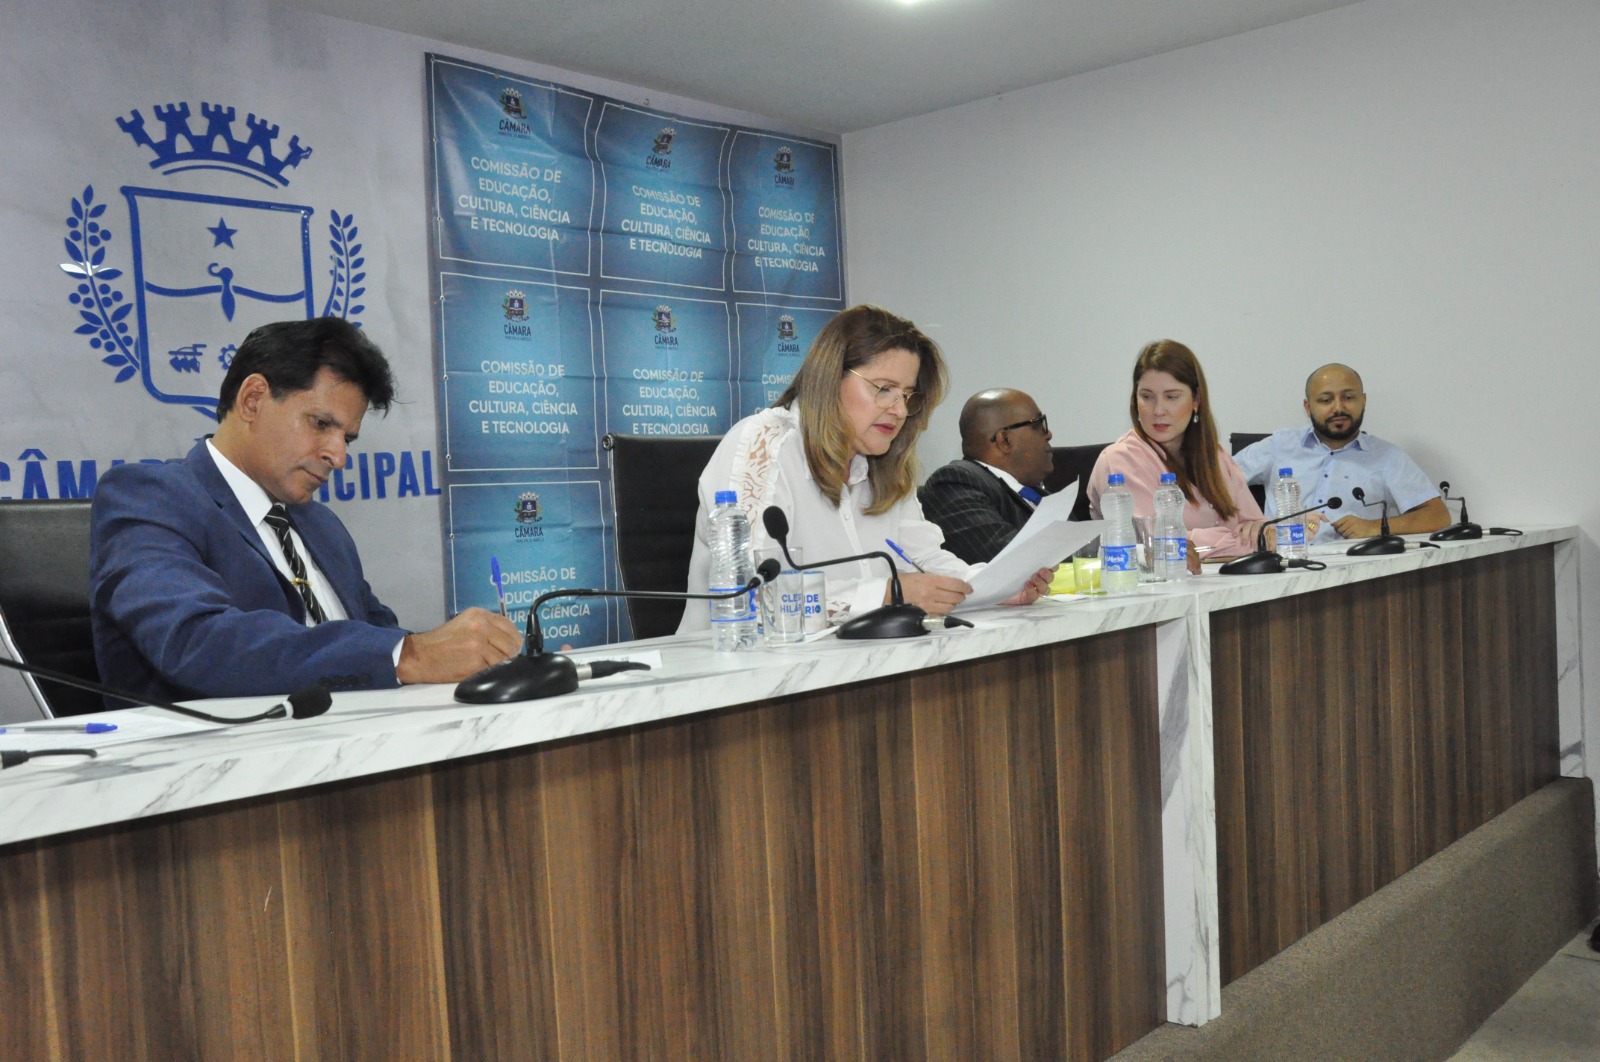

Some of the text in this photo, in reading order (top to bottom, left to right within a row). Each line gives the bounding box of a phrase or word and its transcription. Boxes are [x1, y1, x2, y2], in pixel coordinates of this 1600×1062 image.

[471, 157, 562, 183] COMISSÃO DE
[479, 177, 551, 203] EDUCAÇÃO,
[632, 185, 701, 207] COMISSÃO DE
[458, 194, 571, 223] CULTURA, CIÊNCIA
[640, 203, 697, 225] EDUCAÇÃO,
[758, 206, 815, 223] COMISSÃO DE
[471, 217, 560, 241] E TECNOLOGIA
[621, 219, 711, 243] CULTURA, CIÊNCIA
[761, 224, 810, 241] EDUCAÇÃO,
[630, 238, 702, 258] E TECNOLOGIA
[748, 239, 825, 256] CULTURA, CIÊNCIA
[755, 256, 818, 272] E TECNOLOGIA
[504, 322, 531, 336] CÂMARA
[655, 334, 679, 346] CÂMARA
[481, 360, 565, 377] COMISSÃO DE
[633, 368, 704, 382] COMISSÃO DE
[761, 374, 795, 385] COMIS
[489, 380, 559, 397] EDUCAÇÃO,
[639, 386, 700, 401] EDUCAÇÃO,
[469, 400, 578, 416] CULTURA, CIÊNCIA
[622, 404, 717, 418] CULTURA, CIÊNCIA
[482, 421, 569, 434] E TECNOLOGIA
[632, 423, 709, 435] E TECNOLOGIA
[319, 450, 441, 503] CIPAL
[514, 525, 544, 538] CÂMARA
[561, 567, 576, 580] DE
[541, 603, 590, 620] CIÊNCIA
